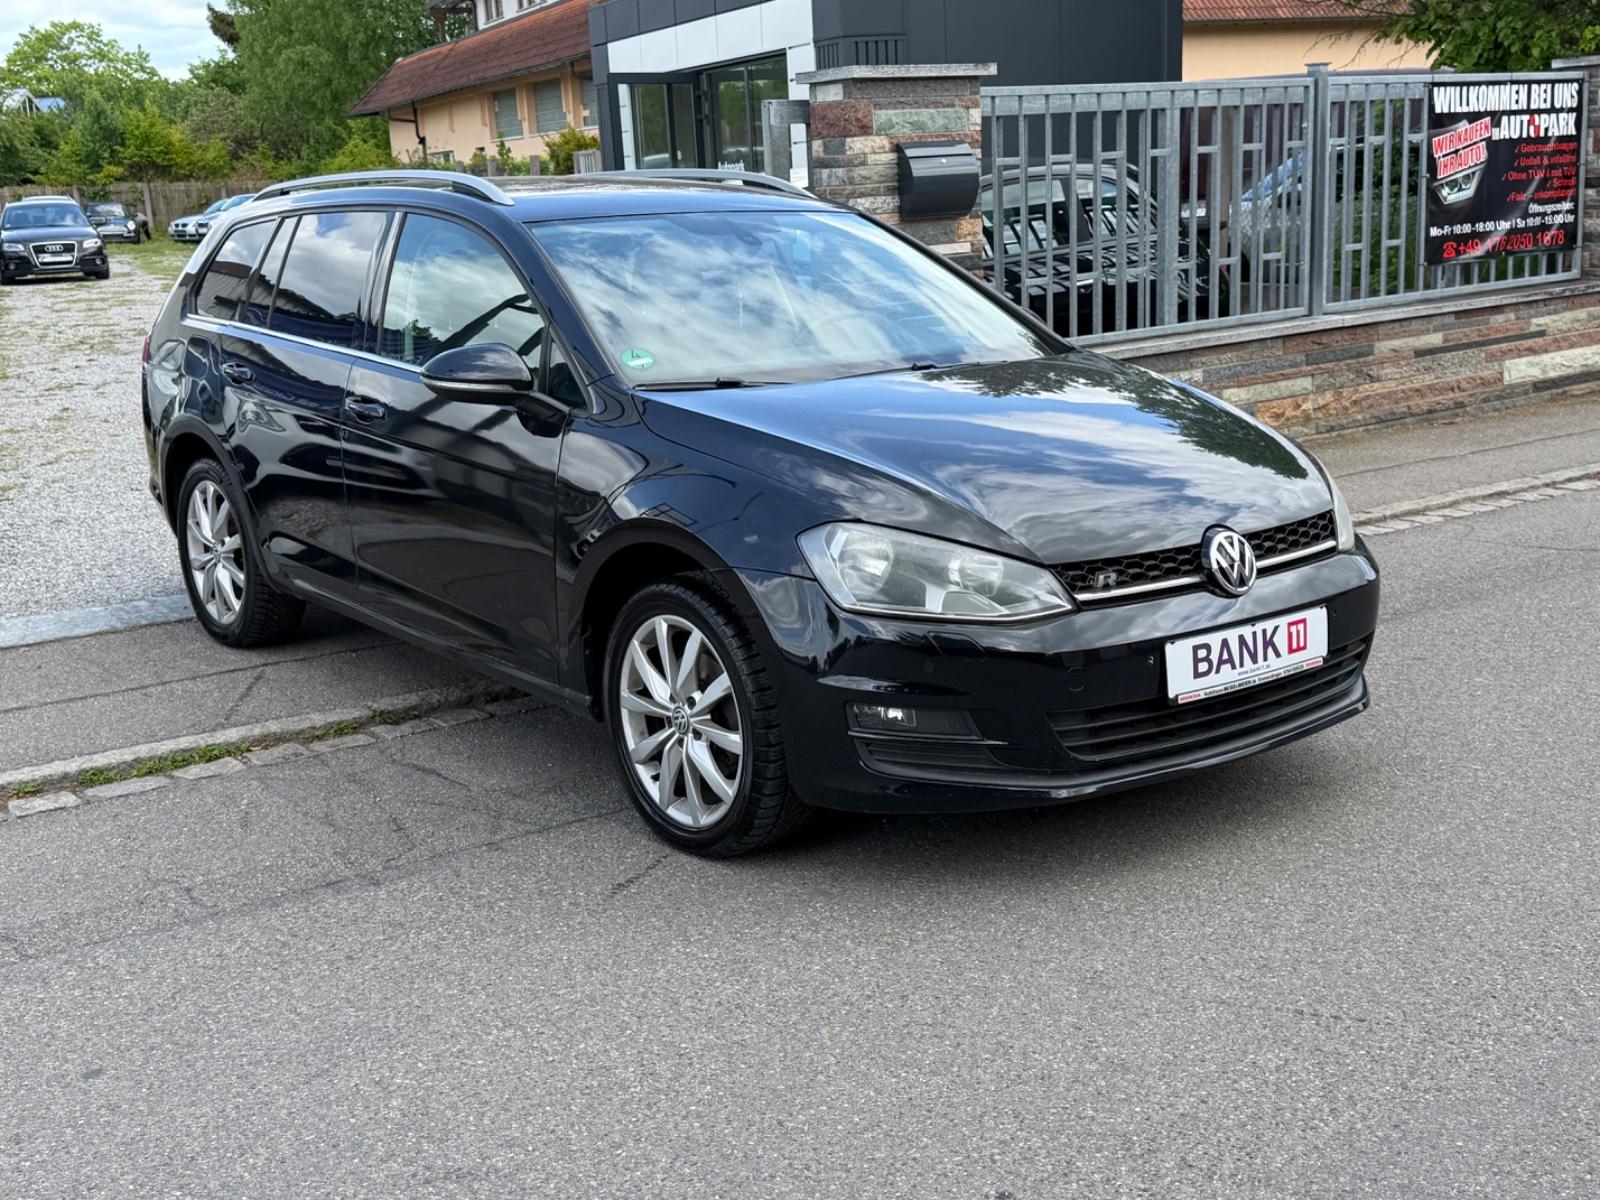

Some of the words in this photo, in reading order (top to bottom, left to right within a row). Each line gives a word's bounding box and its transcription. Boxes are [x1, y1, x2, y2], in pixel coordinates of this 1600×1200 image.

[1433, 85, 1529, 113] WILLKOMMEN
[1529, 83, 1552, 109] BEI
[1554, 83, 1578, 108] UNS
[1433, 133, 1455, 157] WIR
[1456, 119, 1490, 146] KAUFEN
[1500, 113, 1577, 139] AUTOPARK
[1438, 155, 1456, 177] IHR
[1457, 143, 1486, 169] AUTO!
[1507, 171, 1527, 181] Ohne
[1430, 224, 1452, 237] Mo-Fr
[1496, 219, 1511, 230] Uhr
[1458, 238, 1482, 254] +49
[1096, 571, 1118, 588] R
[1192, 624, 1282, 680] BANK
